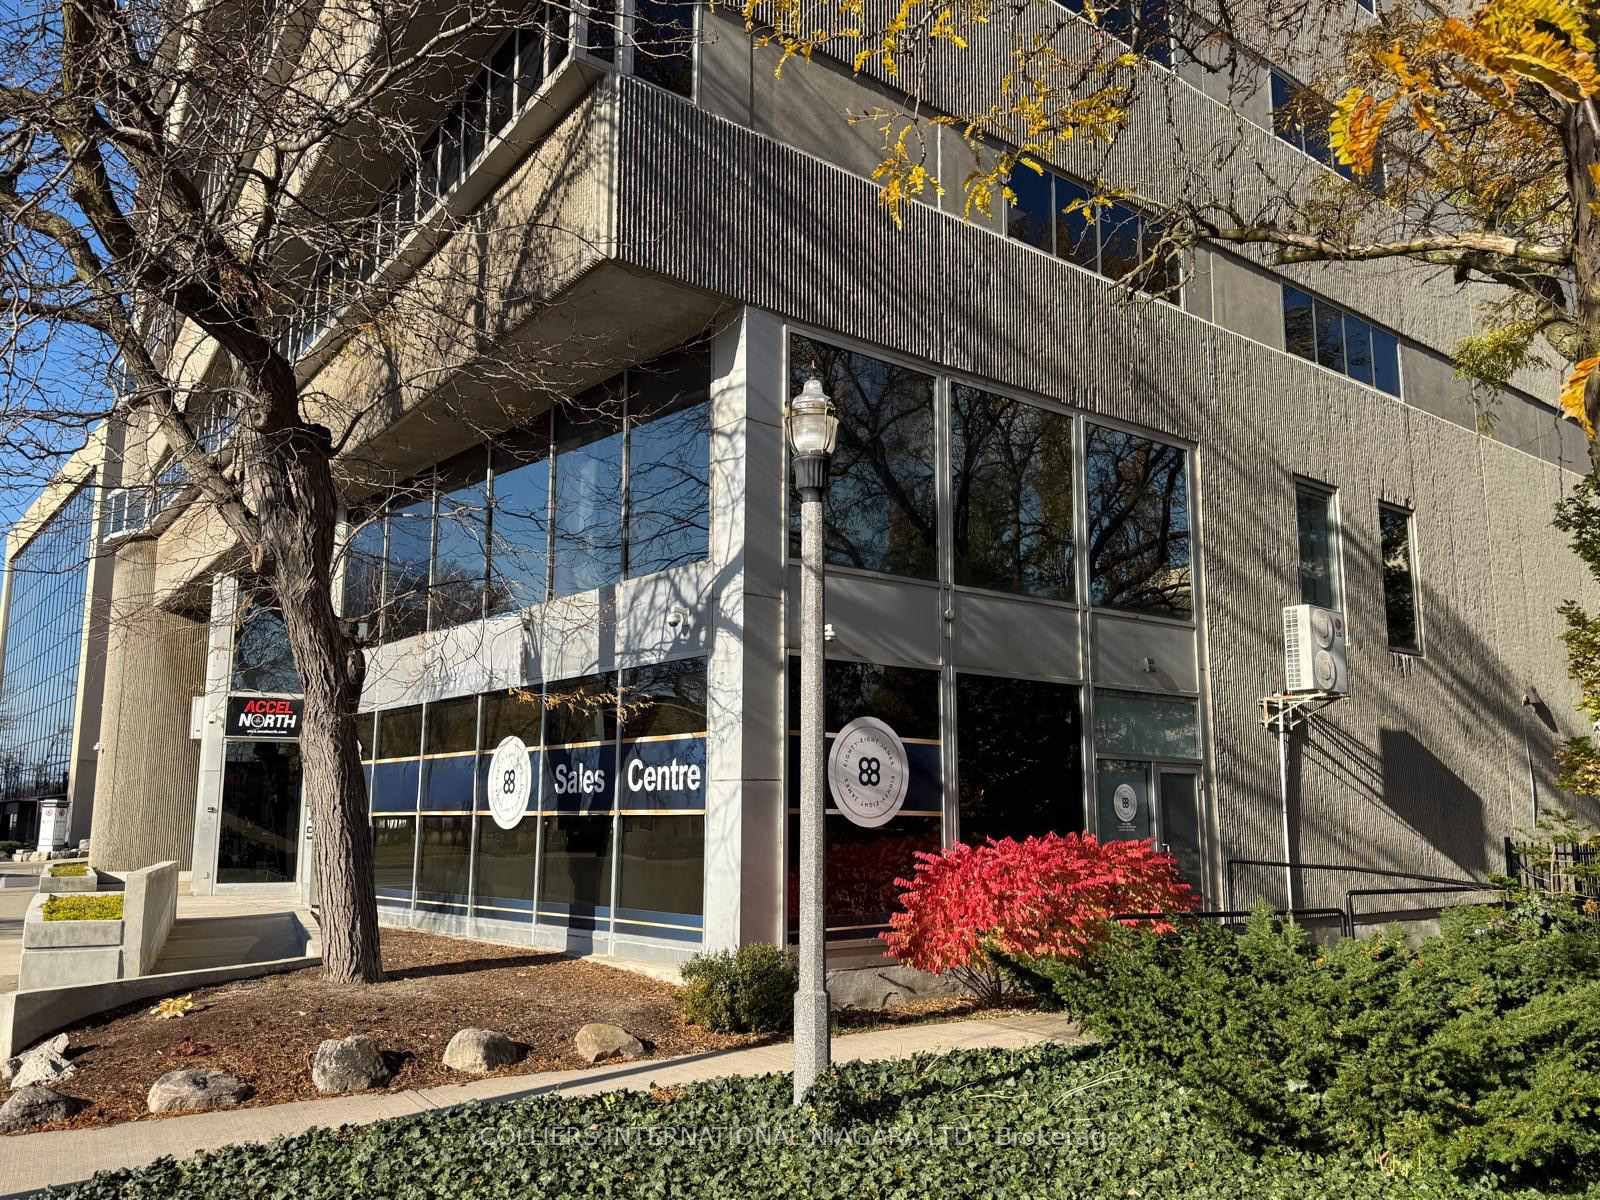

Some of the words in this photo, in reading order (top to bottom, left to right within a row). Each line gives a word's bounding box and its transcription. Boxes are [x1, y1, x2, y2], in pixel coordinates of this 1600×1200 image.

[243, 700, 293, 714] ACCEL
[238, 713, 297, 728] NORTH
[503, 769, 516, 794] 88
[554, 763, 606, 795] Sales
[627, 757, 702, 793] Centre
[859, 757, 880, 786] 88
